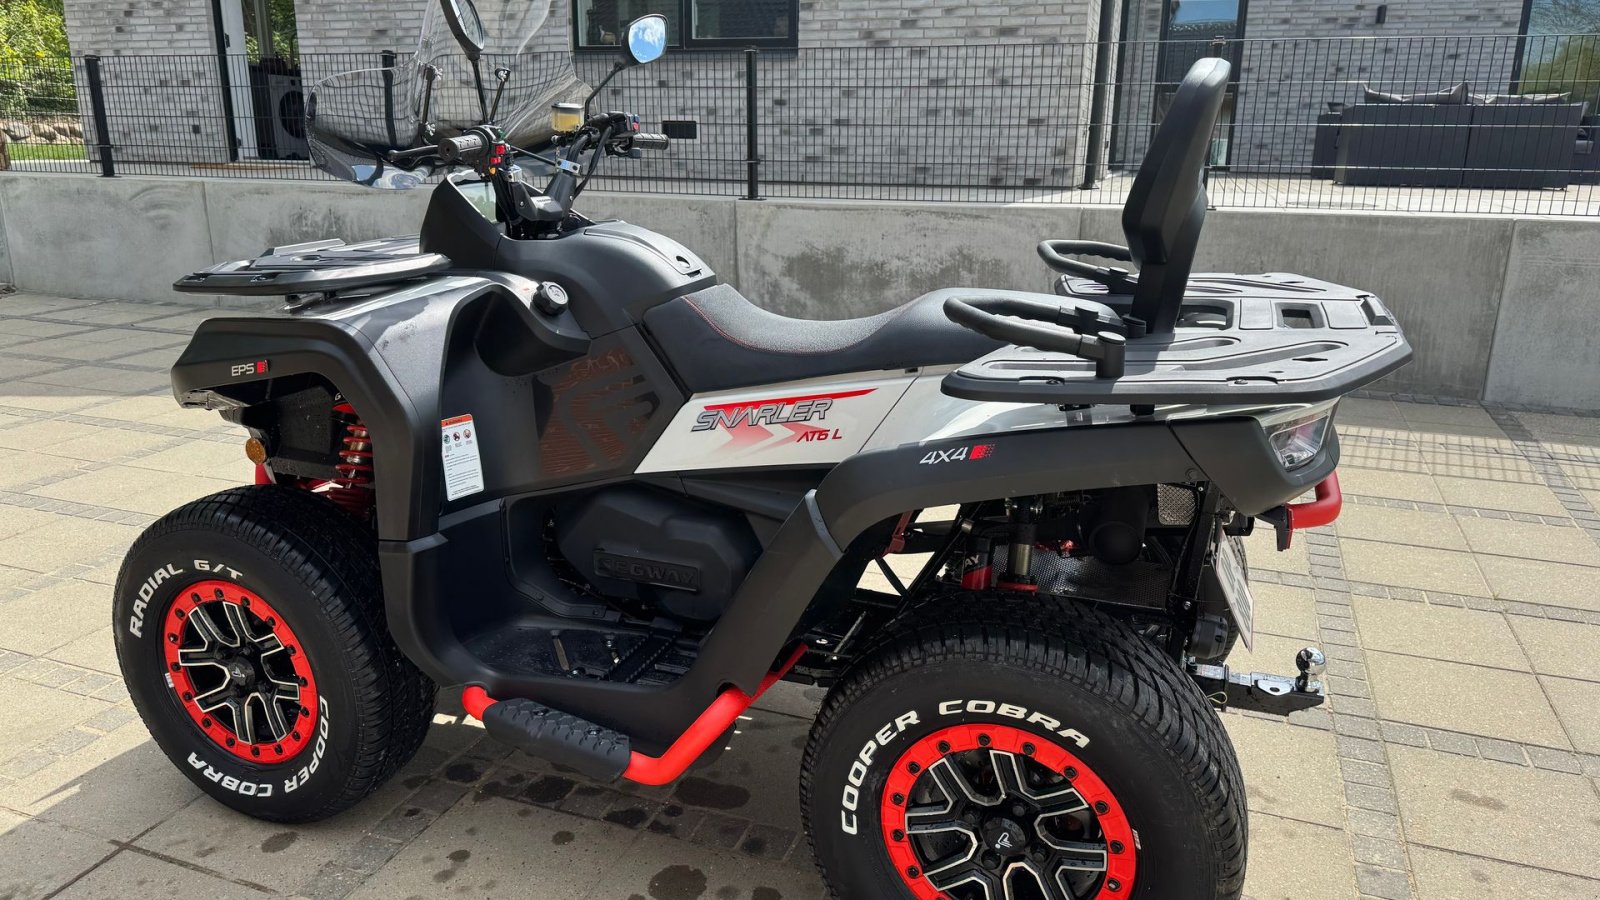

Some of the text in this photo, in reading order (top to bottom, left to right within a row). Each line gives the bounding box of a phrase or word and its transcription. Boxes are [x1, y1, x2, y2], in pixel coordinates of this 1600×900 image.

[231, 362, 255, 377] EPS
[690, 398, 833, 433] SNARLER
[797, 428, 843, 443] AT6 L
[597, 556, 696, 585] SEGWAY
[129, 559, 243, 639] RADIAL G/T
[186, 694, 330, 798] COOPER COBRA
[841, 699, 1091, 836] COOPER COBRA
